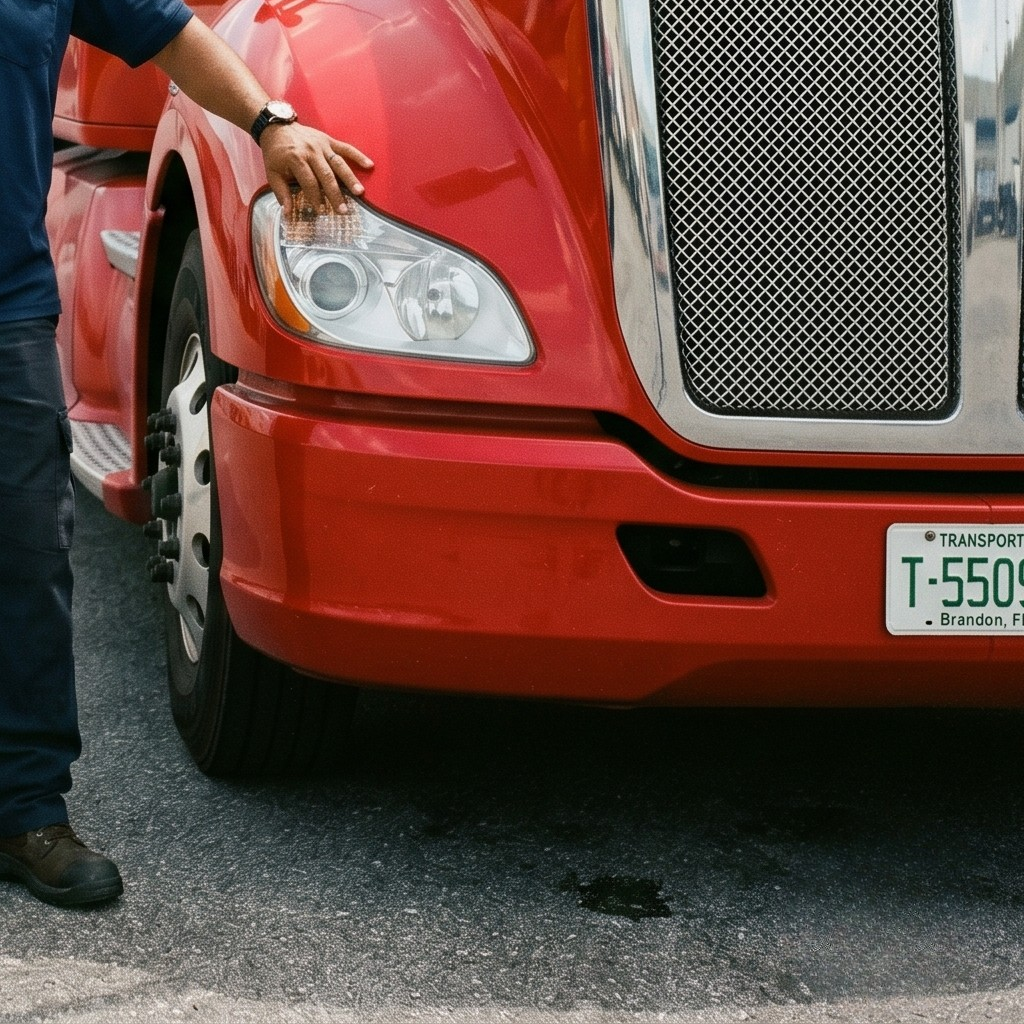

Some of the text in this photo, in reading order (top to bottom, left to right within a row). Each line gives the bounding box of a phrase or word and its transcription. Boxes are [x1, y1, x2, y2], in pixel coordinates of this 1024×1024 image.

[901, 556, 1024, 608] T-550
[940, 612, 1024, 629] Brandon, F
